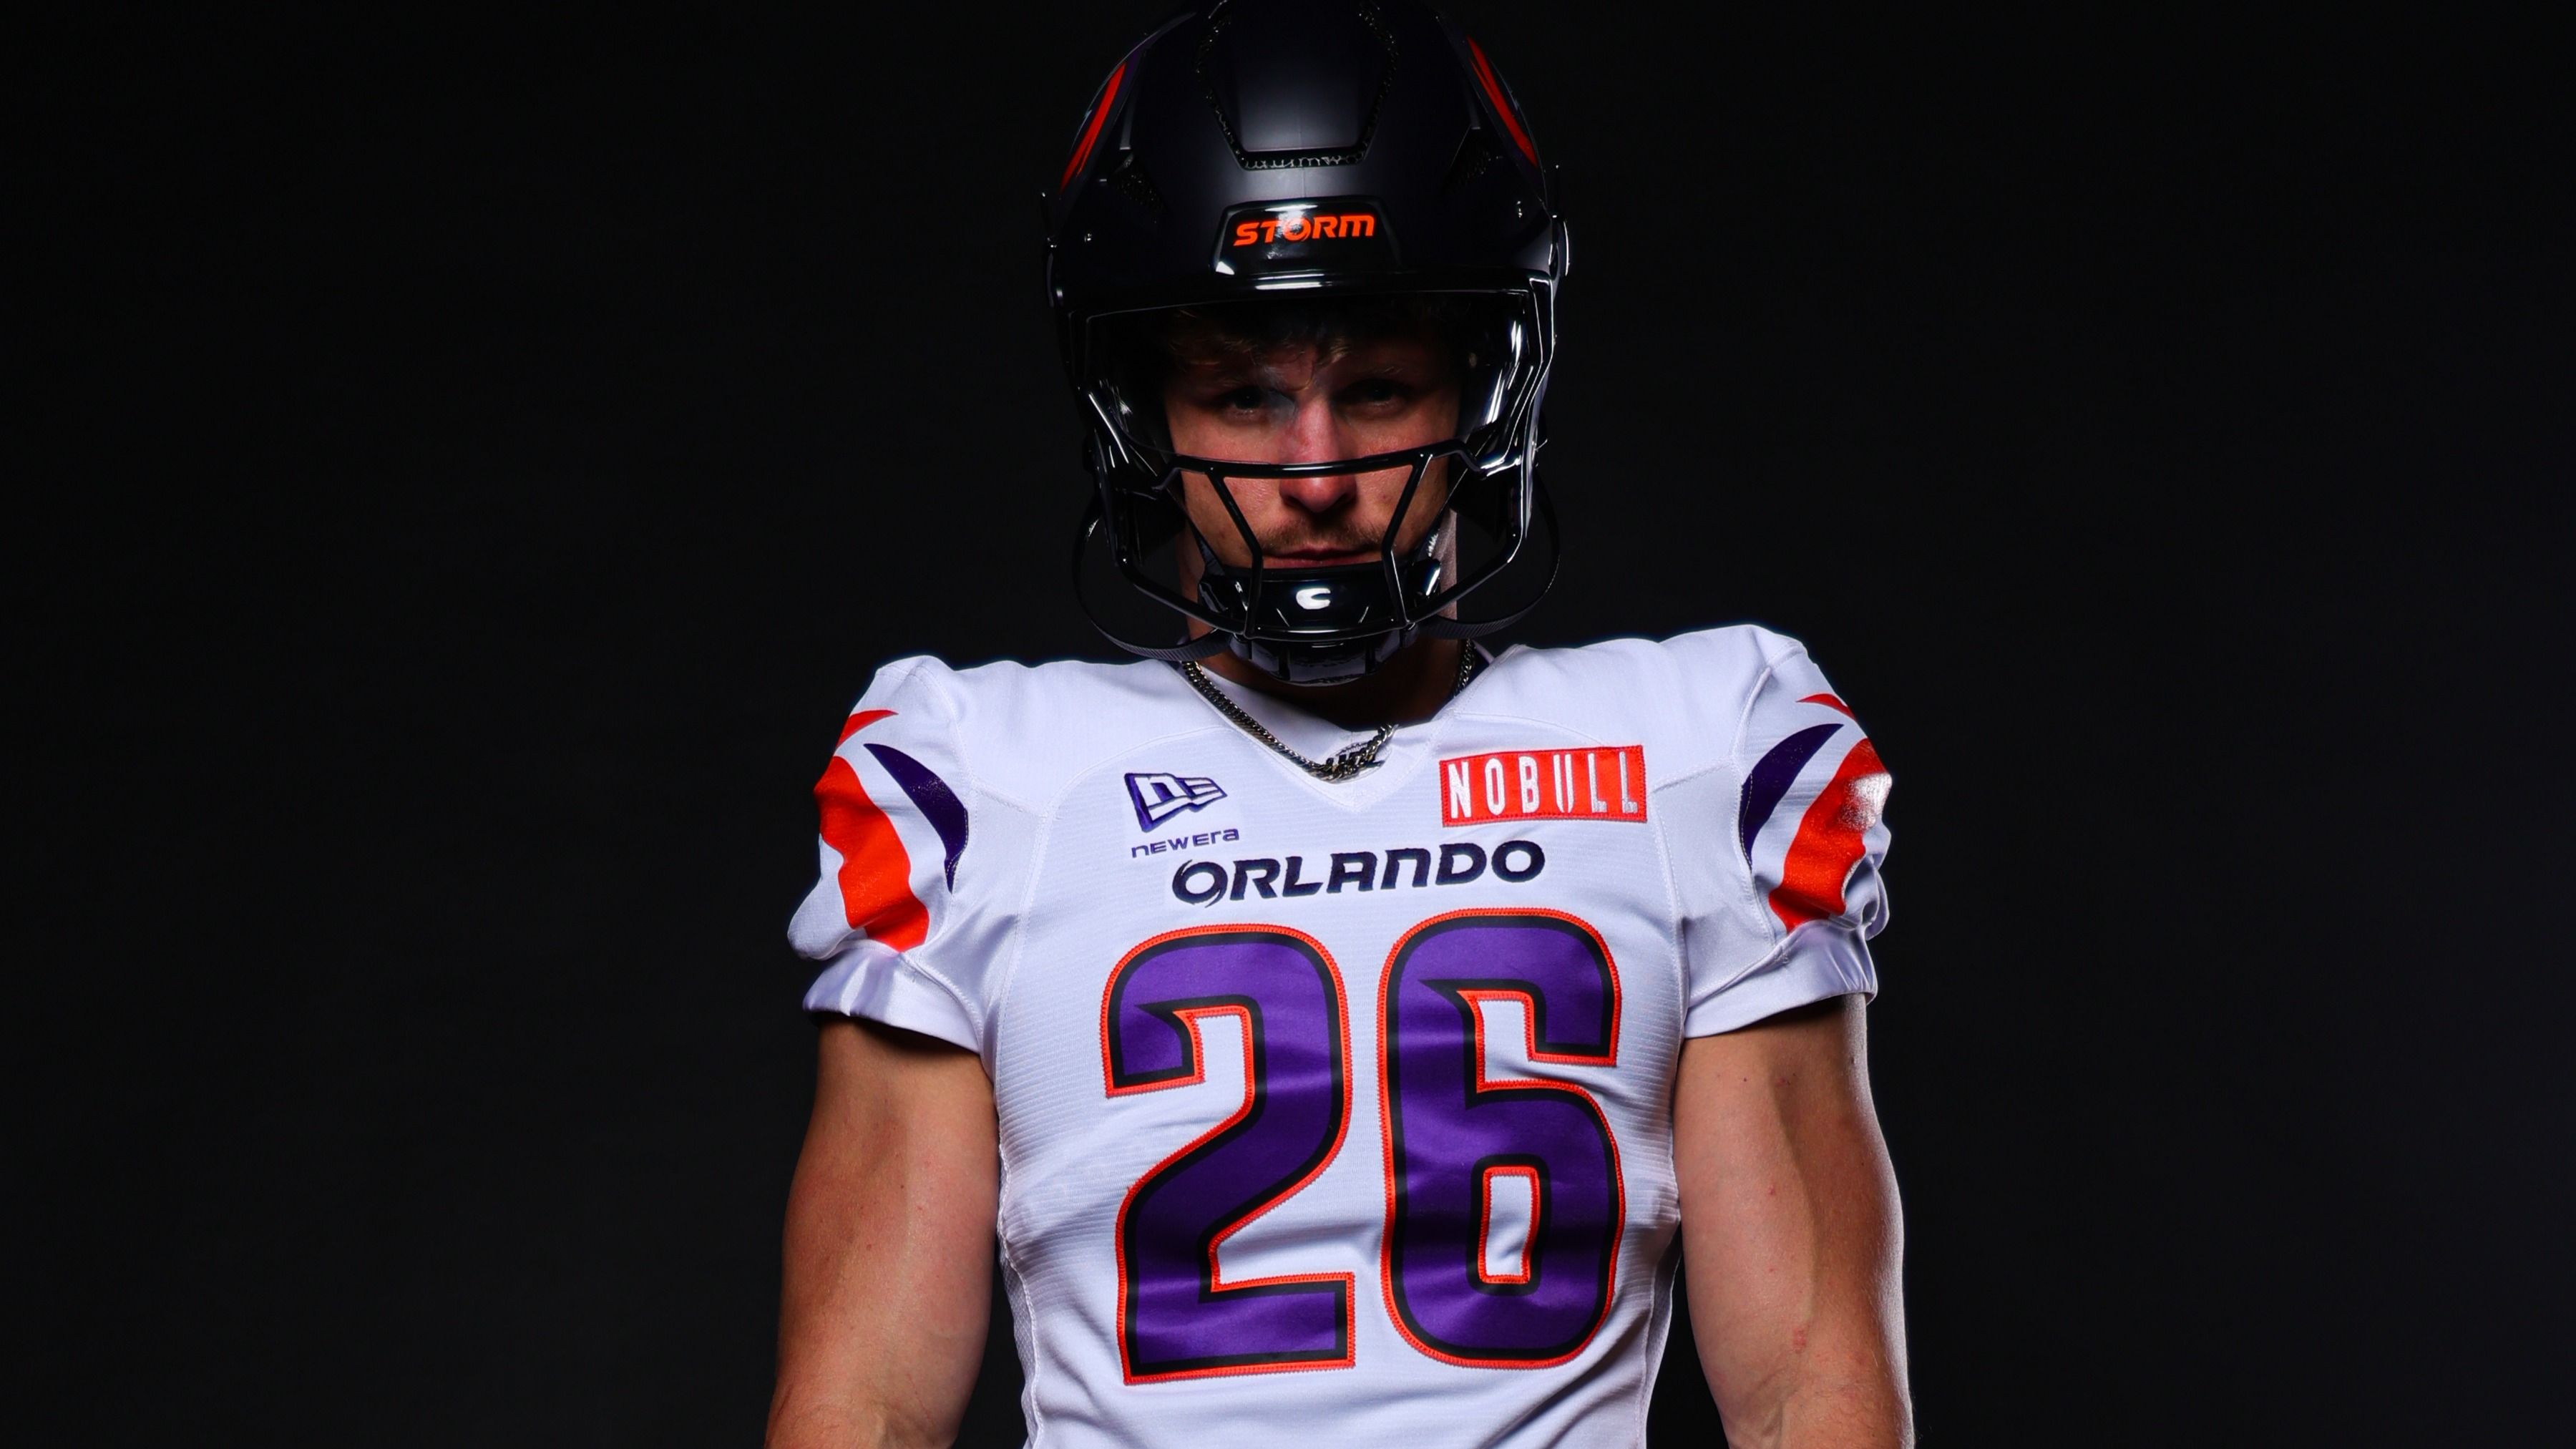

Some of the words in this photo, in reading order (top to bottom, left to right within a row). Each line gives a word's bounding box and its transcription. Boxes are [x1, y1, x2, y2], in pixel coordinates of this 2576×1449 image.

[1233, 215, 1375, 246] STORM
[1448, 751, 1639, 819] NOBULL
[1172, 840, 1545, 908] ORLANDO
[1101, 907, 1626, 1385] 26
